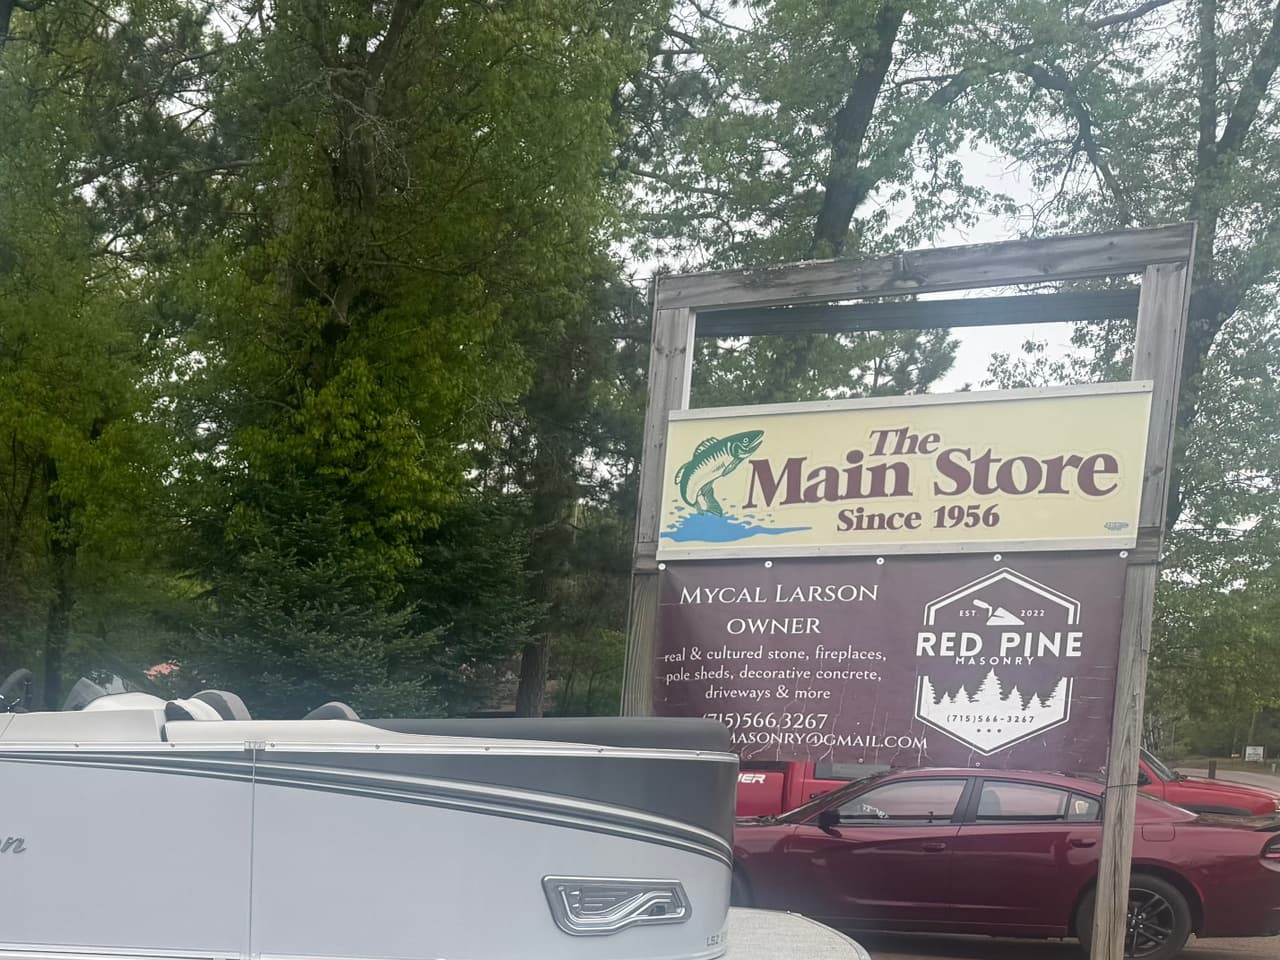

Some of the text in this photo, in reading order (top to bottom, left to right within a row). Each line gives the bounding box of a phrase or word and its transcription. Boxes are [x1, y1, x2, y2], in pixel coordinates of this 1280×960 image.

[869, 427, 941, 457] The
[742, 447, 1119, 509] Main Store
[836, 504, 1001, 532] Since 1956
[679, 584, 879, 605] MYCAL LARSON
[1020, 609, 1045, 617] 2022
[726, 617, 822, 635] OWNER
[663, 645, 887, 662] real & cultured stone, fireplaces,
[916, 631, 1083, 657] RED PINE
[955, 656, 1035, 665] MASONRY
[665, 664, 882, 685] pole sheds, decorative concrete,
[705, 684, 831, 701] driveways & more
[946, 714, 1035, 724] (715)566-3267
